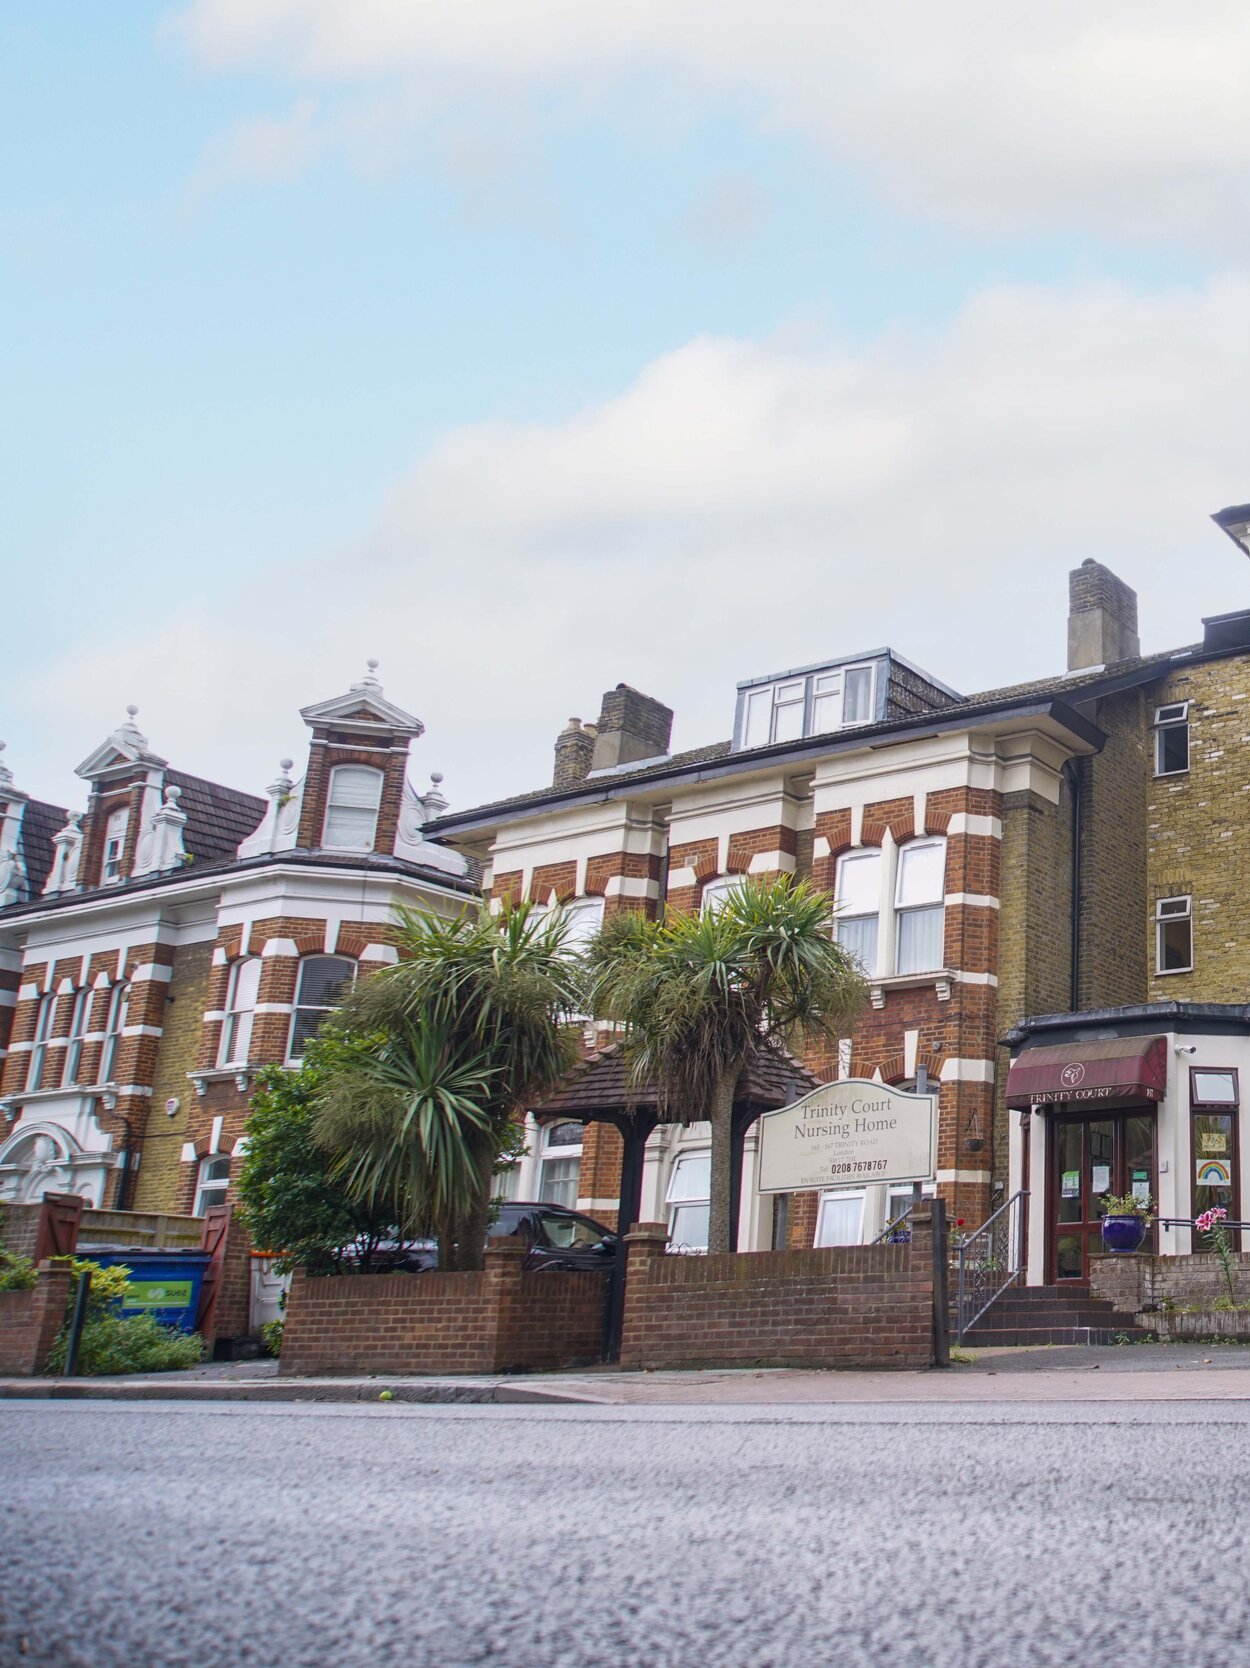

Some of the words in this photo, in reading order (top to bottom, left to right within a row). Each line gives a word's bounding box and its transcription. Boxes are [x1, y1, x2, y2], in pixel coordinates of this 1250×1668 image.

[1028, 1090, 1073, 1104] TRINITY
[1075, 1087, 1112, 1099] COURT
[801, 1104, 847, 1120] Trinity
[851, 1098, 892, 1114] Court
[794, 1122, 850, 1138] Nursing
[854, 1118, 897, 1133] Home
[834, 1141, 858, 1149] TRINITY
[860, 1138, 878, 1146] ROAD
[831, 1163, 851, 1174] 0208
[853, 1160, 888, 1172] 7678767
